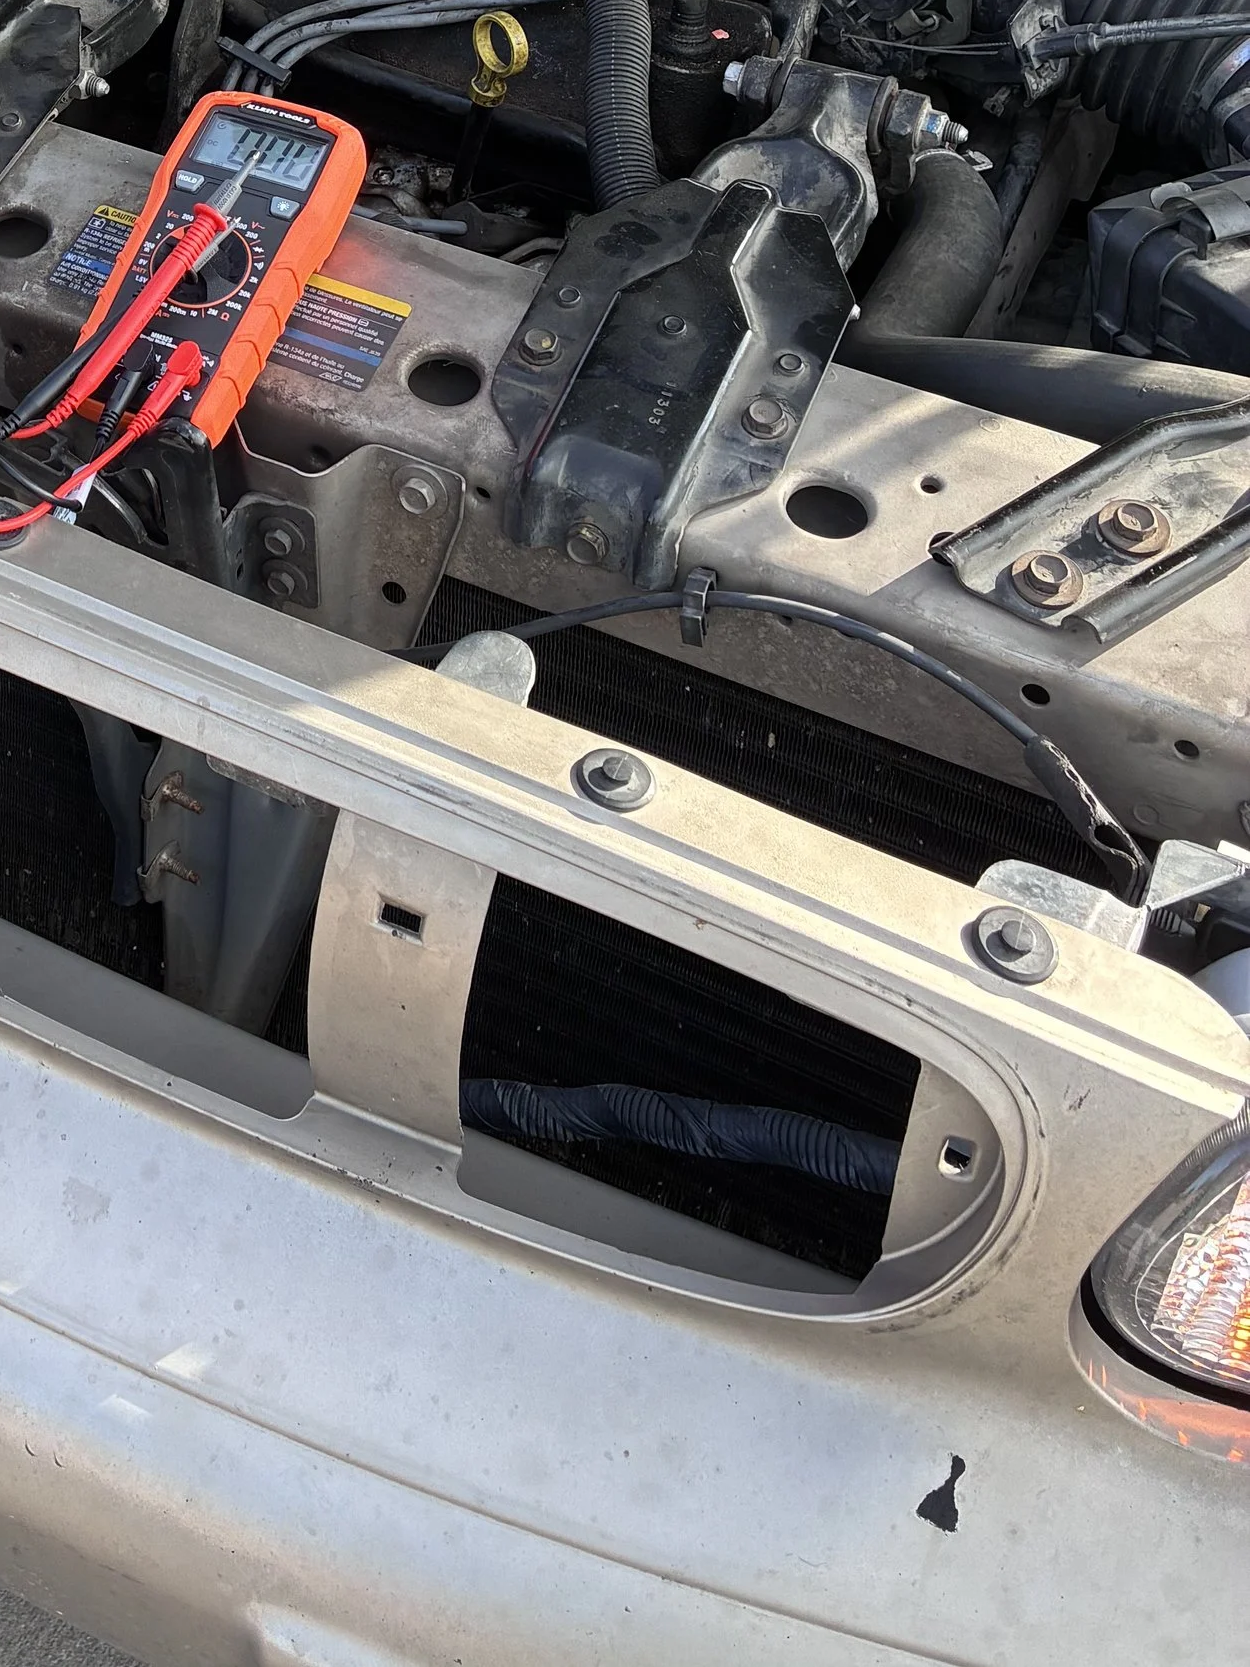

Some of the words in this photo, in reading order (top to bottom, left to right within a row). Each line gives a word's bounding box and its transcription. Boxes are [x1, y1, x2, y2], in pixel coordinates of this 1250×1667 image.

[247, 103, 278, 116] KLEIN
[279, 109, 310, 124] TOOLS
[207, 139, 218, 147] DC
[178, 171, 198, 185] HOLD
[110, 210, 137, 224] CAUTIO
[181, 213, 194, 222] 200
[165, 222, 175, 230] 20
[245, 230, 258, 239] 200
[64, 252, 93, 267] NOTICE
[238, 289, 251, 299] 20k
[168, 305, 187, 316] 200m
[225, 300, 243, 311] 200k
[207, 308, 219, 317] 2M
[308, 302, 327, 313] HAUTE
[327, 309, 358, 323] PRESSION
[150, 331, 174, 343] MM325
[283, 343, 305, 356] R-134a
[343, 371, 365, 384] Charge
